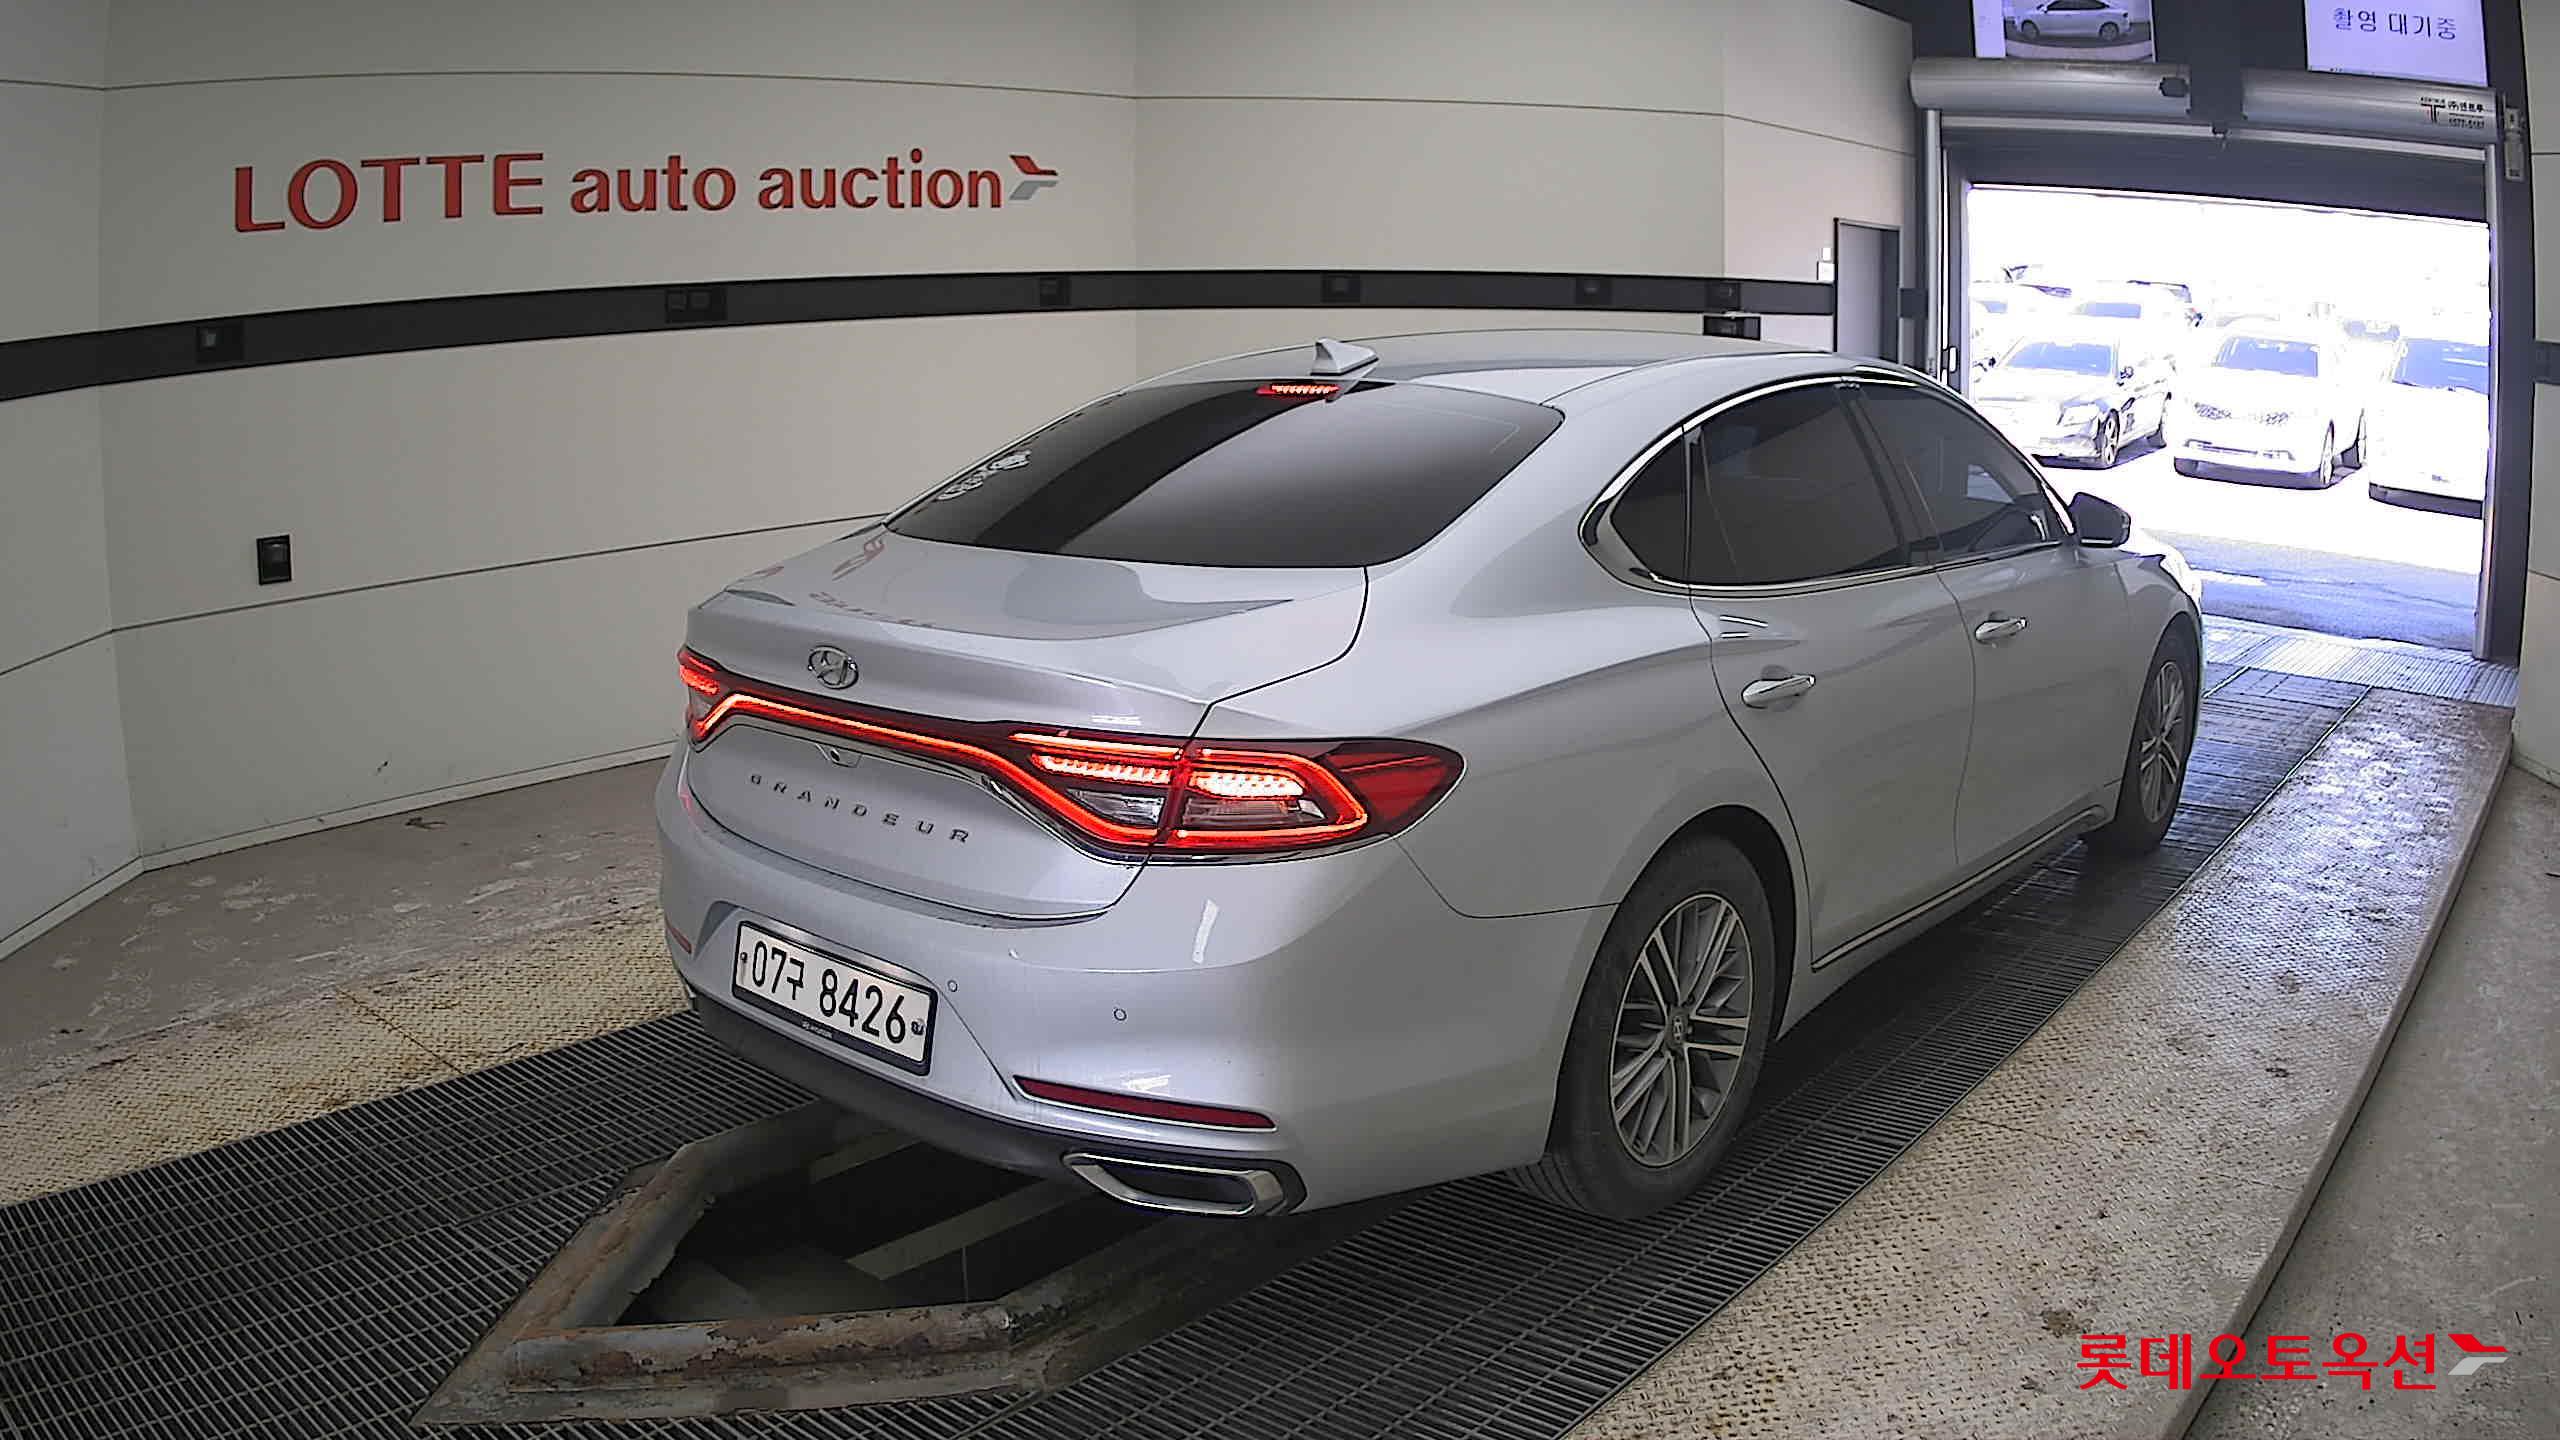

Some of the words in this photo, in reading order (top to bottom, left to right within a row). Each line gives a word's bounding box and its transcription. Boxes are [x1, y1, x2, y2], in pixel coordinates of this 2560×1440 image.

[2333, 8, 2377, 32] 촬영
[2388, 13, 2457, 40] 대기중
[234, 152, 544, 233] LOTTE
[569, 154, 737, 212] auto
[757, 147, 1004, 210] auction
[750, 774, 970, 843] GRANDEUR
[751, 940, 806, 1001] 07구
[818, 968, 907, 1044] 8426
